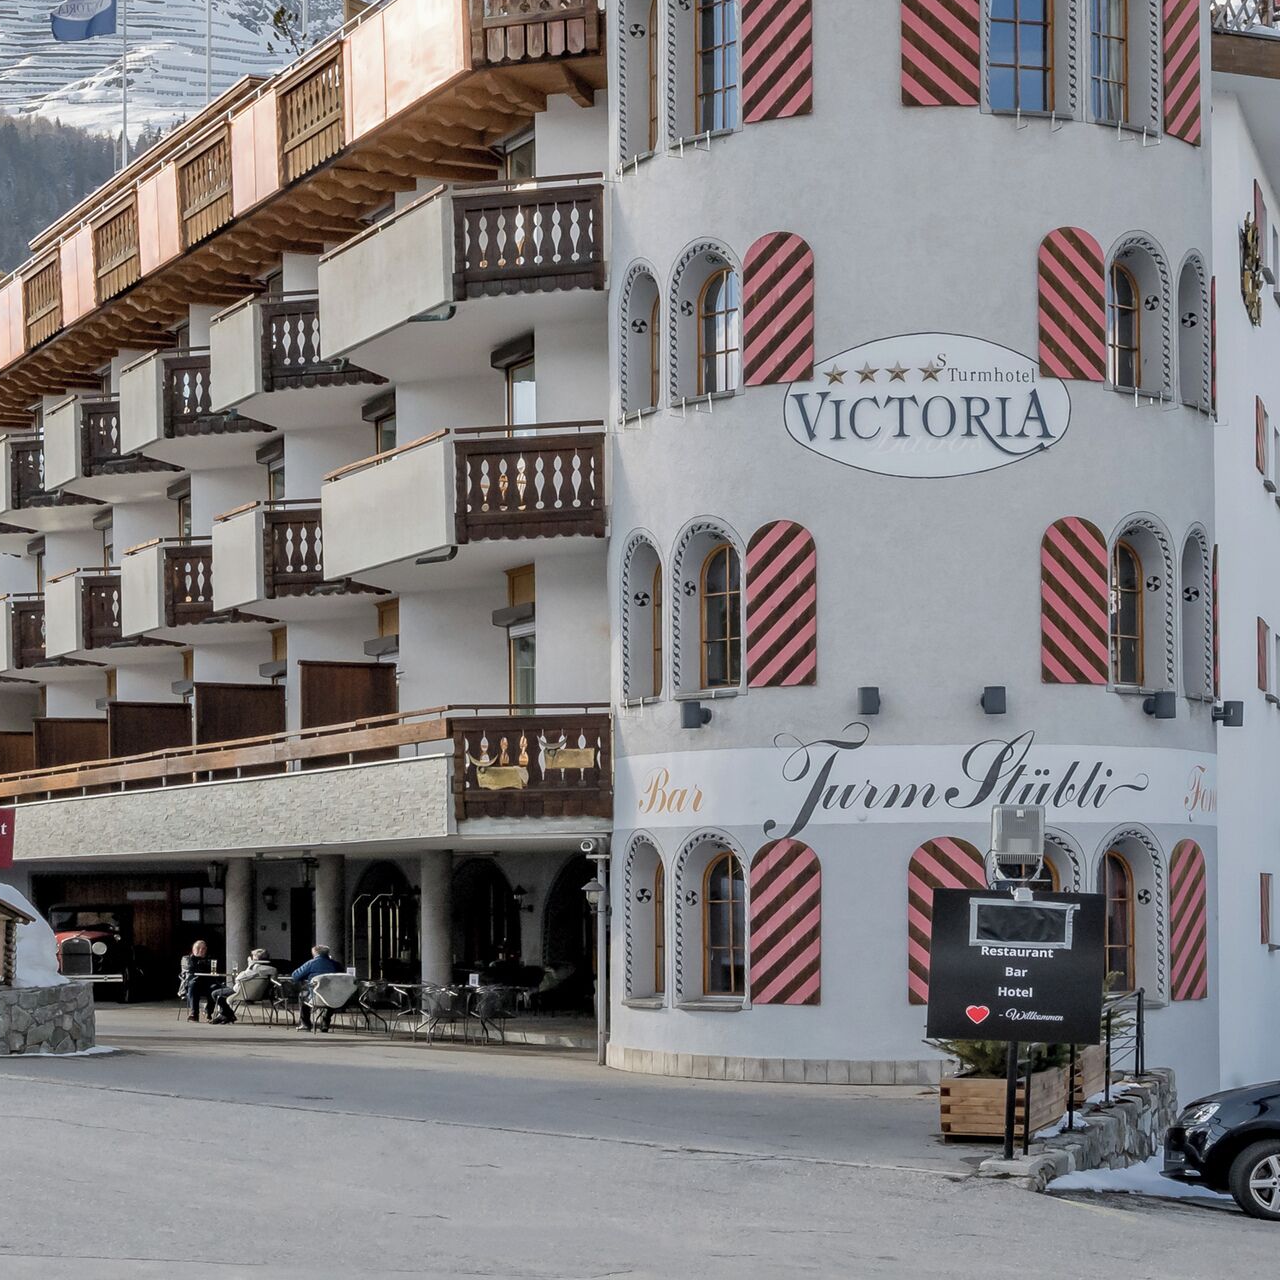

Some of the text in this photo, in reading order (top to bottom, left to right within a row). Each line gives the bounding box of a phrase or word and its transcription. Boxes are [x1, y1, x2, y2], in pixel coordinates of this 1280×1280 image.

[947, 367, 1036, 384] Turmhotel
[789, 388, 1056, 455] VICTORIA
[639, 767, 704, 814] Bar
[980, 946, 1054, 959] Restaurant
[1005, 966, 1029, 978] Bar
[997, 986, 1034, 998] Hotel
[1005, 1008, 1064, 1021] Willkommen
